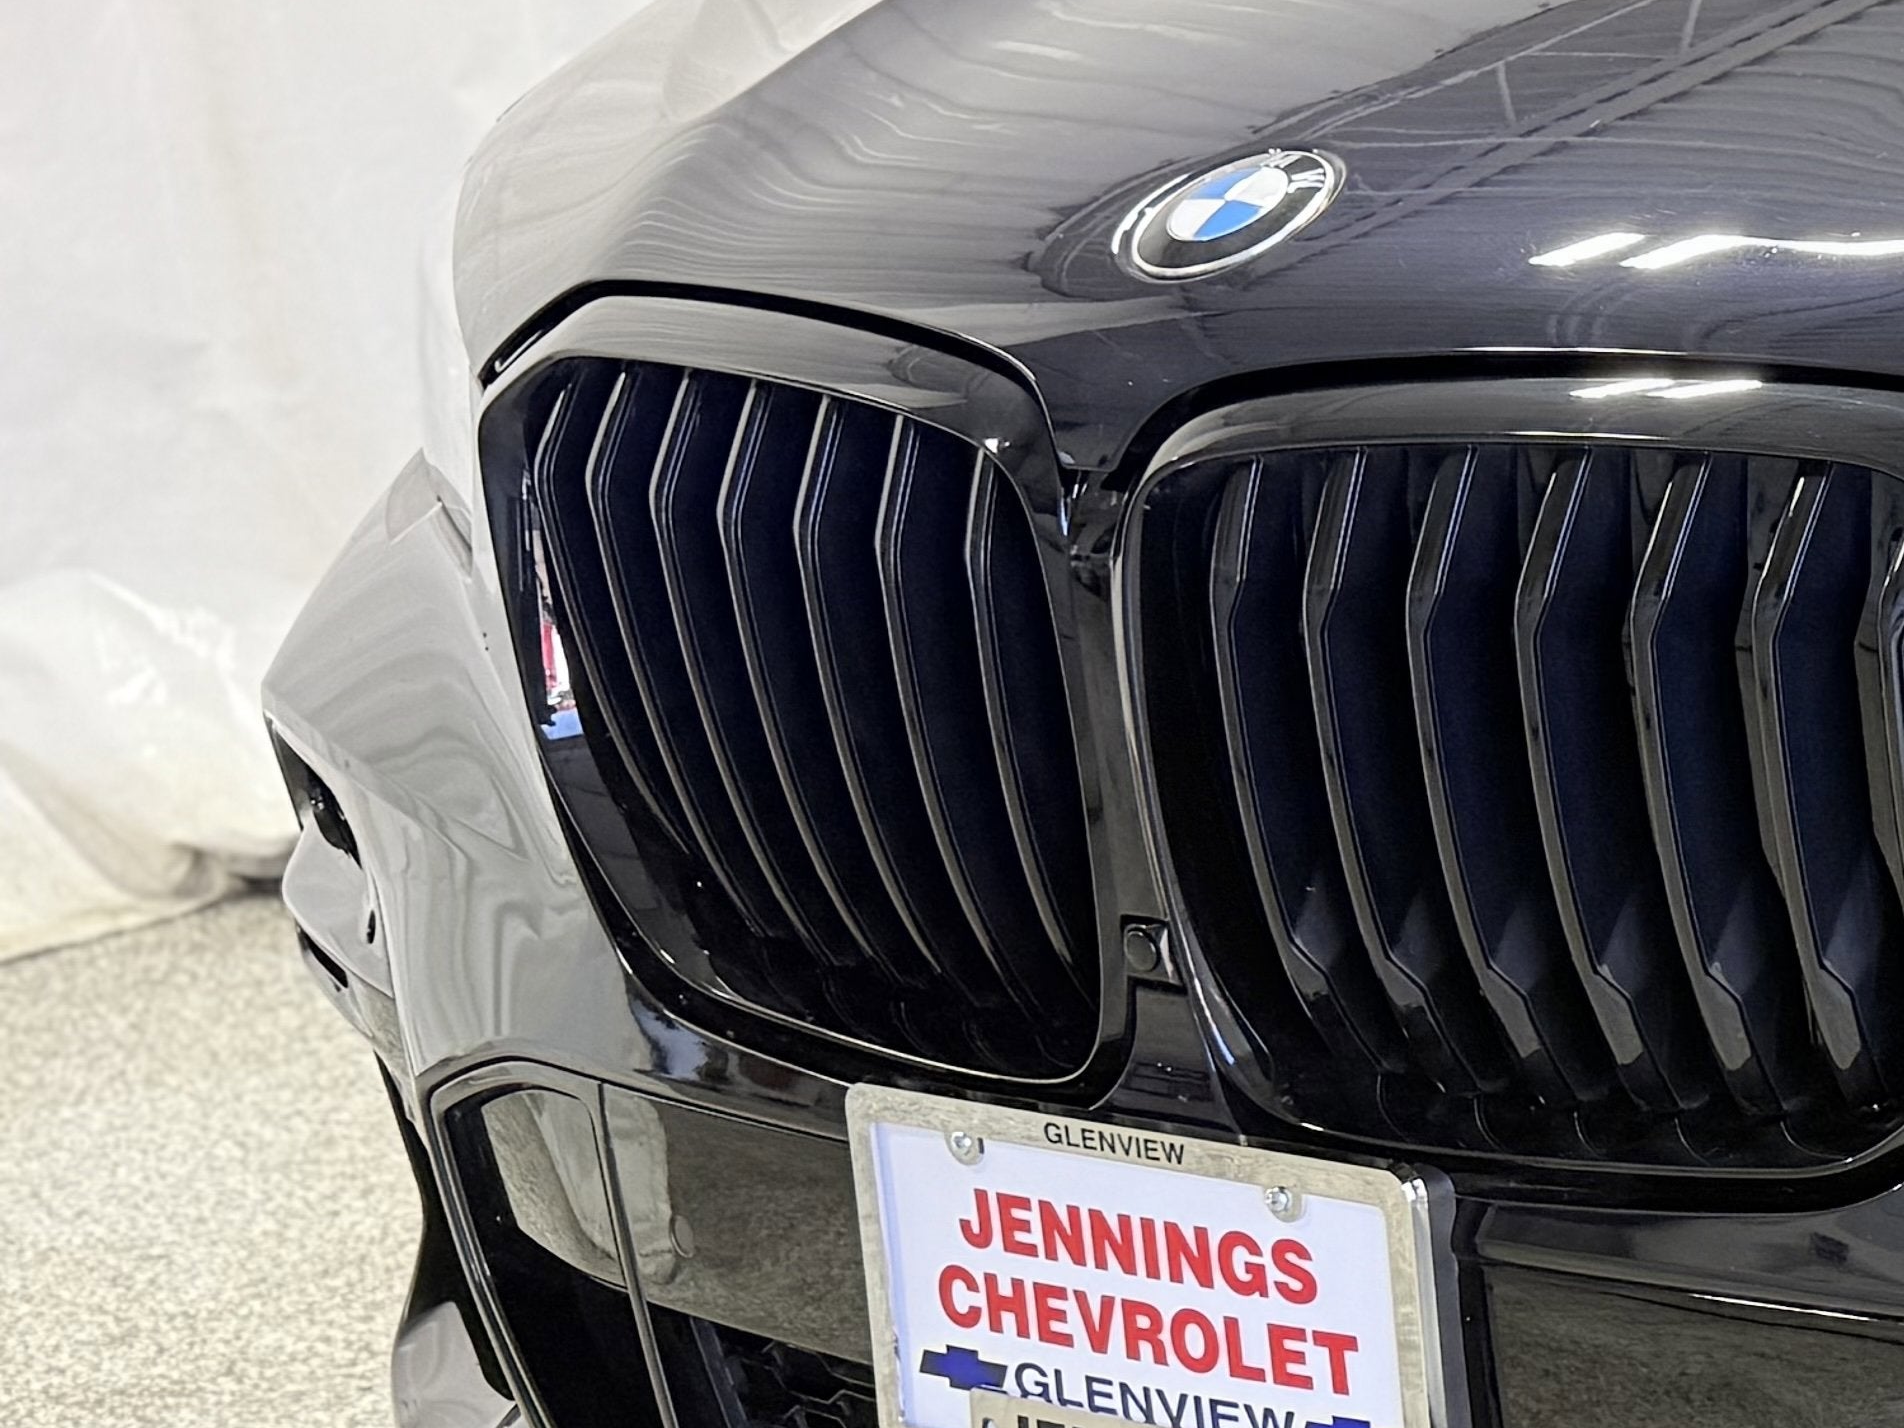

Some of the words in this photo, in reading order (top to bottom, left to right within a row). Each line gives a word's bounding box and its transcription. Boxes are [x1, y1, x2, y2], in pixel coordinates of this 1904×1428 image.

[1043, 1121, 1186, 1165] GLENVIEW
[957, 1187, 1319, 1305] JENNINGS
[937, 1264, 1359, 1396] CHEVROLET
